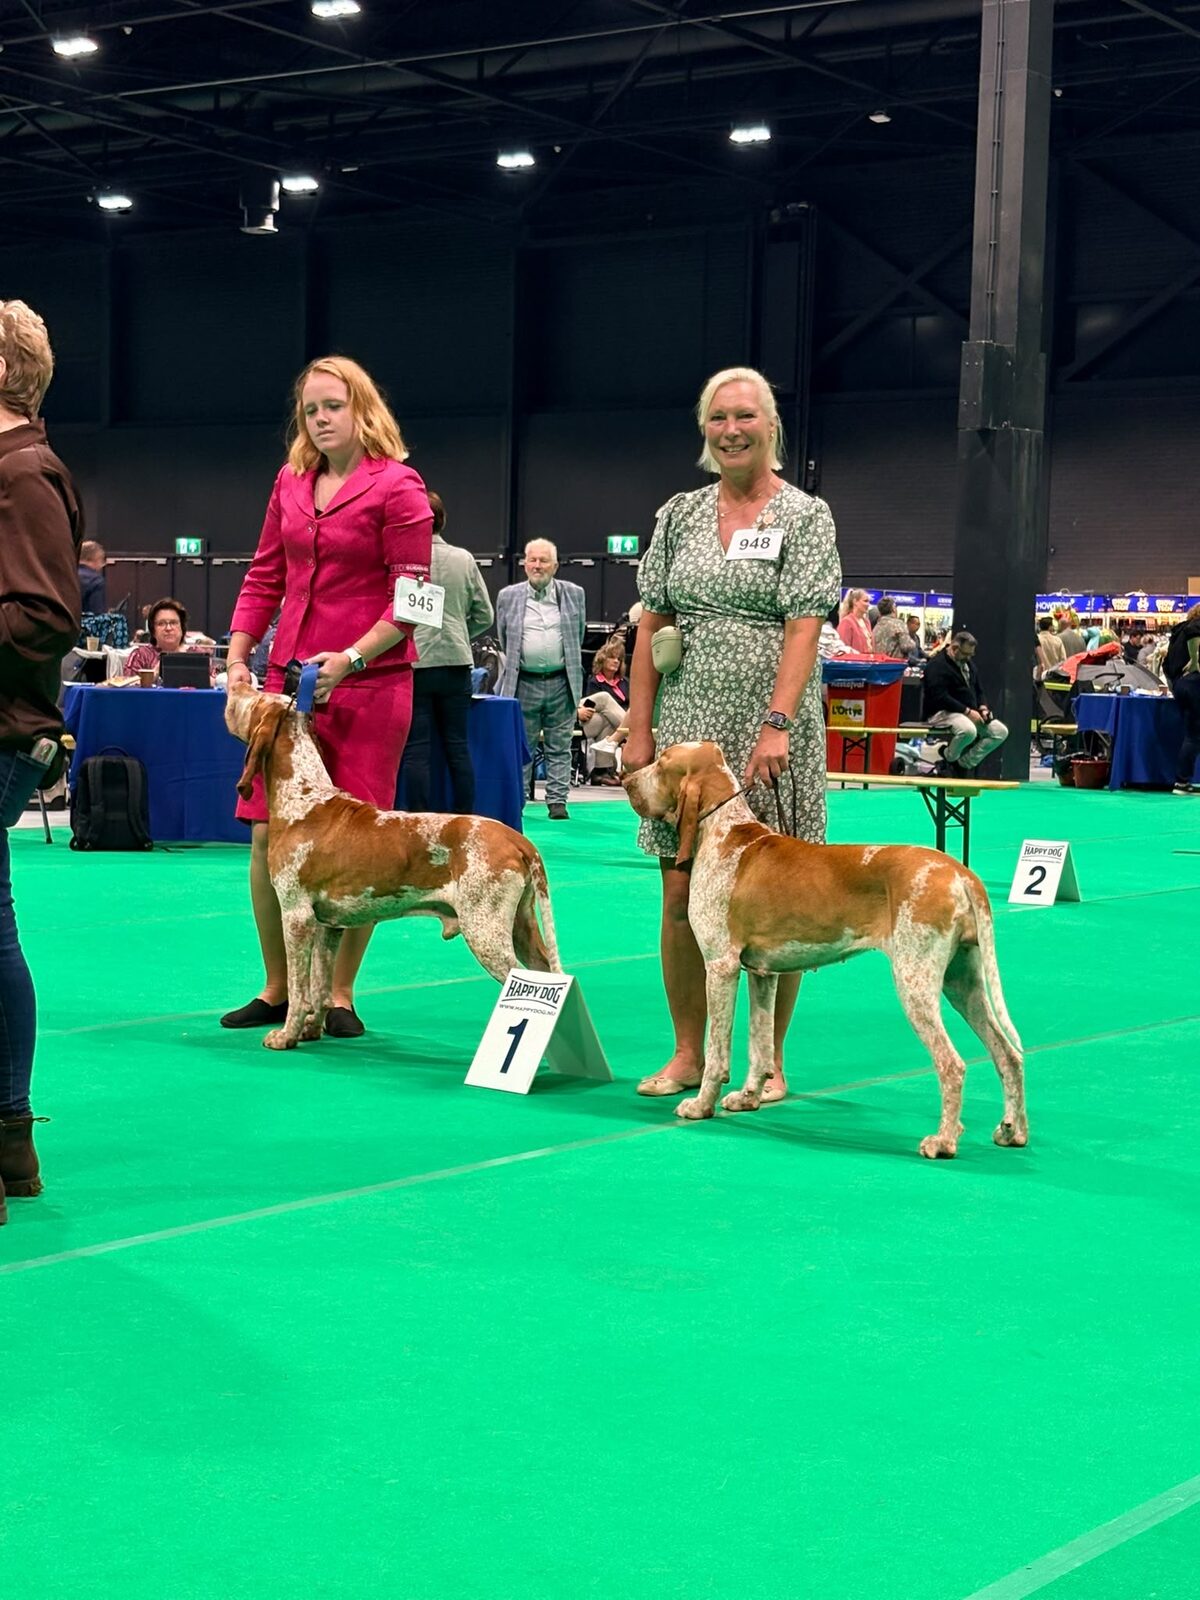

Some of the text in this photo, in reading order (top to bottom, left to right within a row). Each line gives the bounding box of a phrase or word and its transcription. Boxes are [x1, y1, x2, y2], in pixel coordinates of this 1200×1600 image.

[739, 537, 770, 550] 948
[408, 593, 434, 612] 945
[1023, 845, 1063, 858] HAPPY DOG
[1023, 865, 1047, 895] 2
[505, 979, 564, 1004] HAPPY DOG
[499, 1018, 529, 1074] 1
